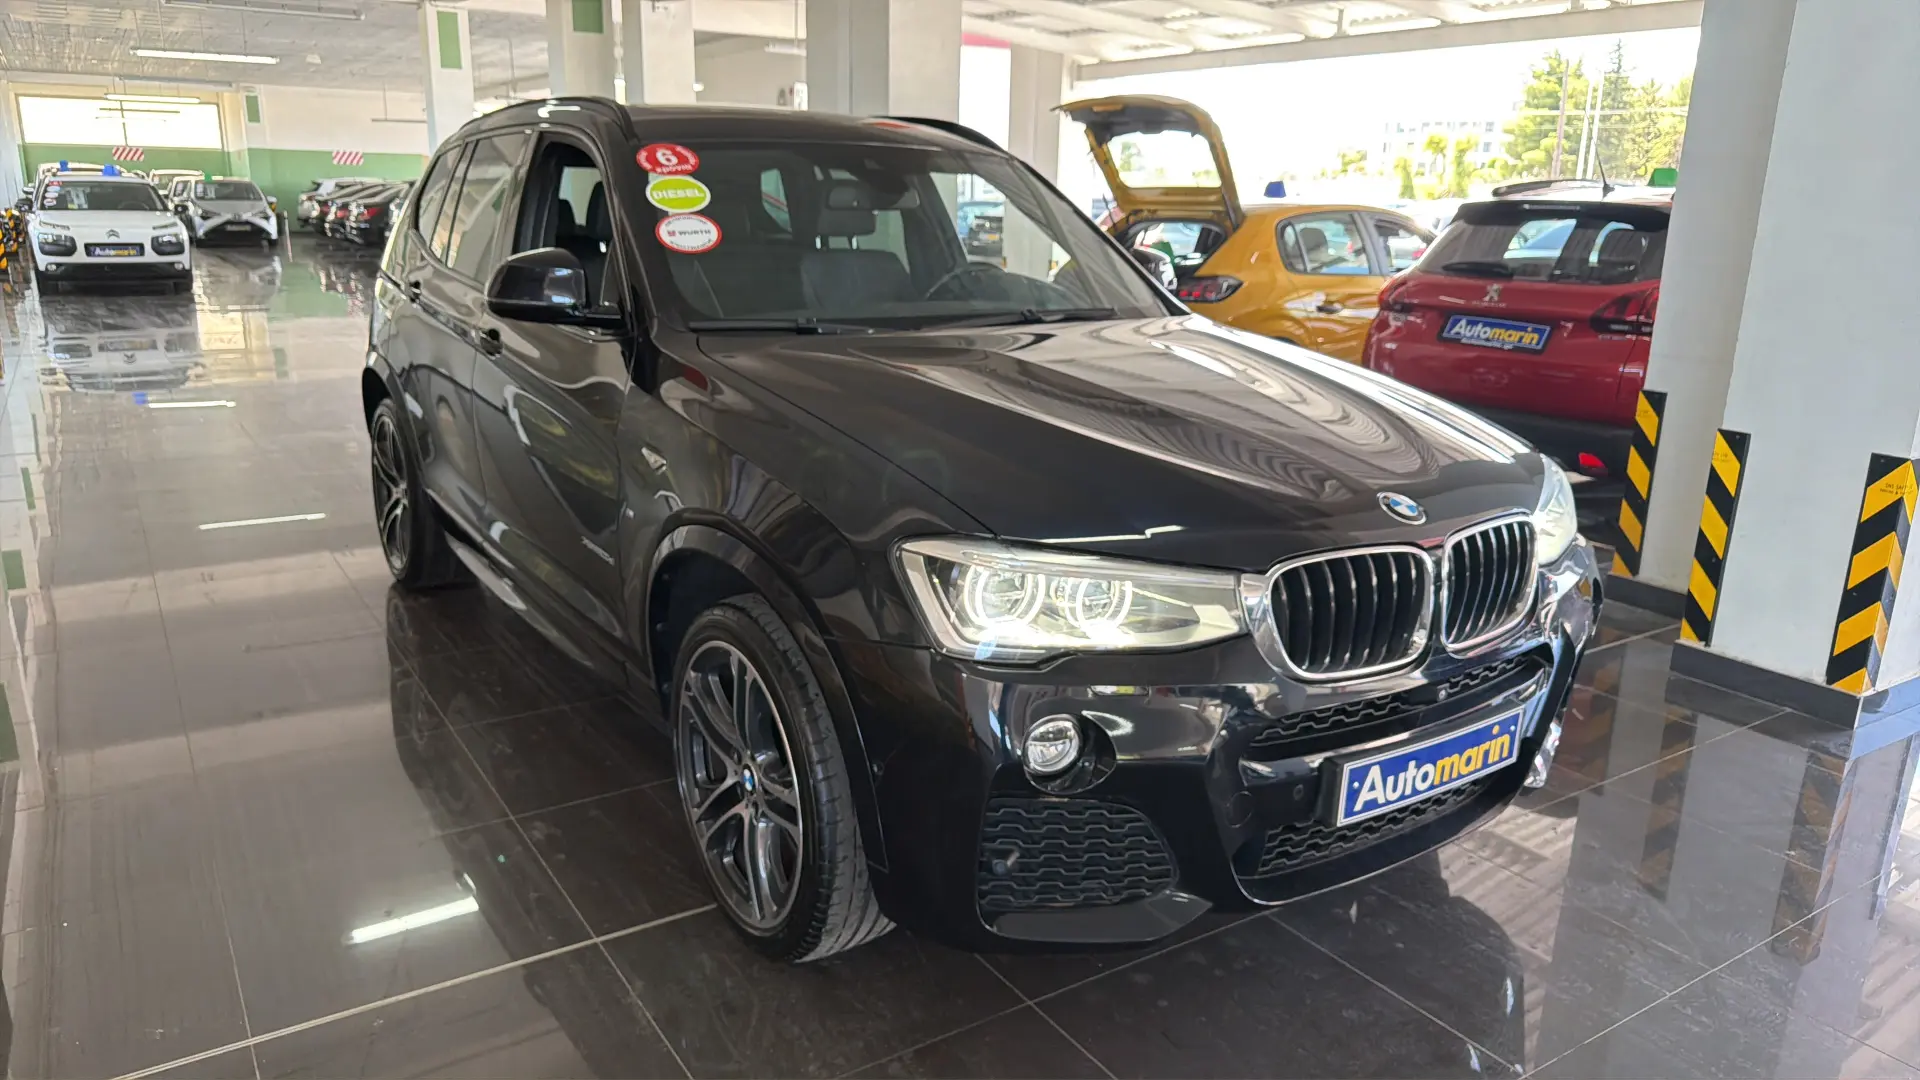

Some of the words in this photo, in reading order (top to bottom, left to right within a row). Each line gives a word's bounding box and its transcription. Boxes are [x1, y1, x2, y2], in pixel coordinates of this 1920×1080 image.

[656, 148, 679, 166] 6
[652, 188, 705, 200] DIESEL
[1450, 318, 1540, 345] Automarin
[1353, 724, 1511, 812] Automarin
